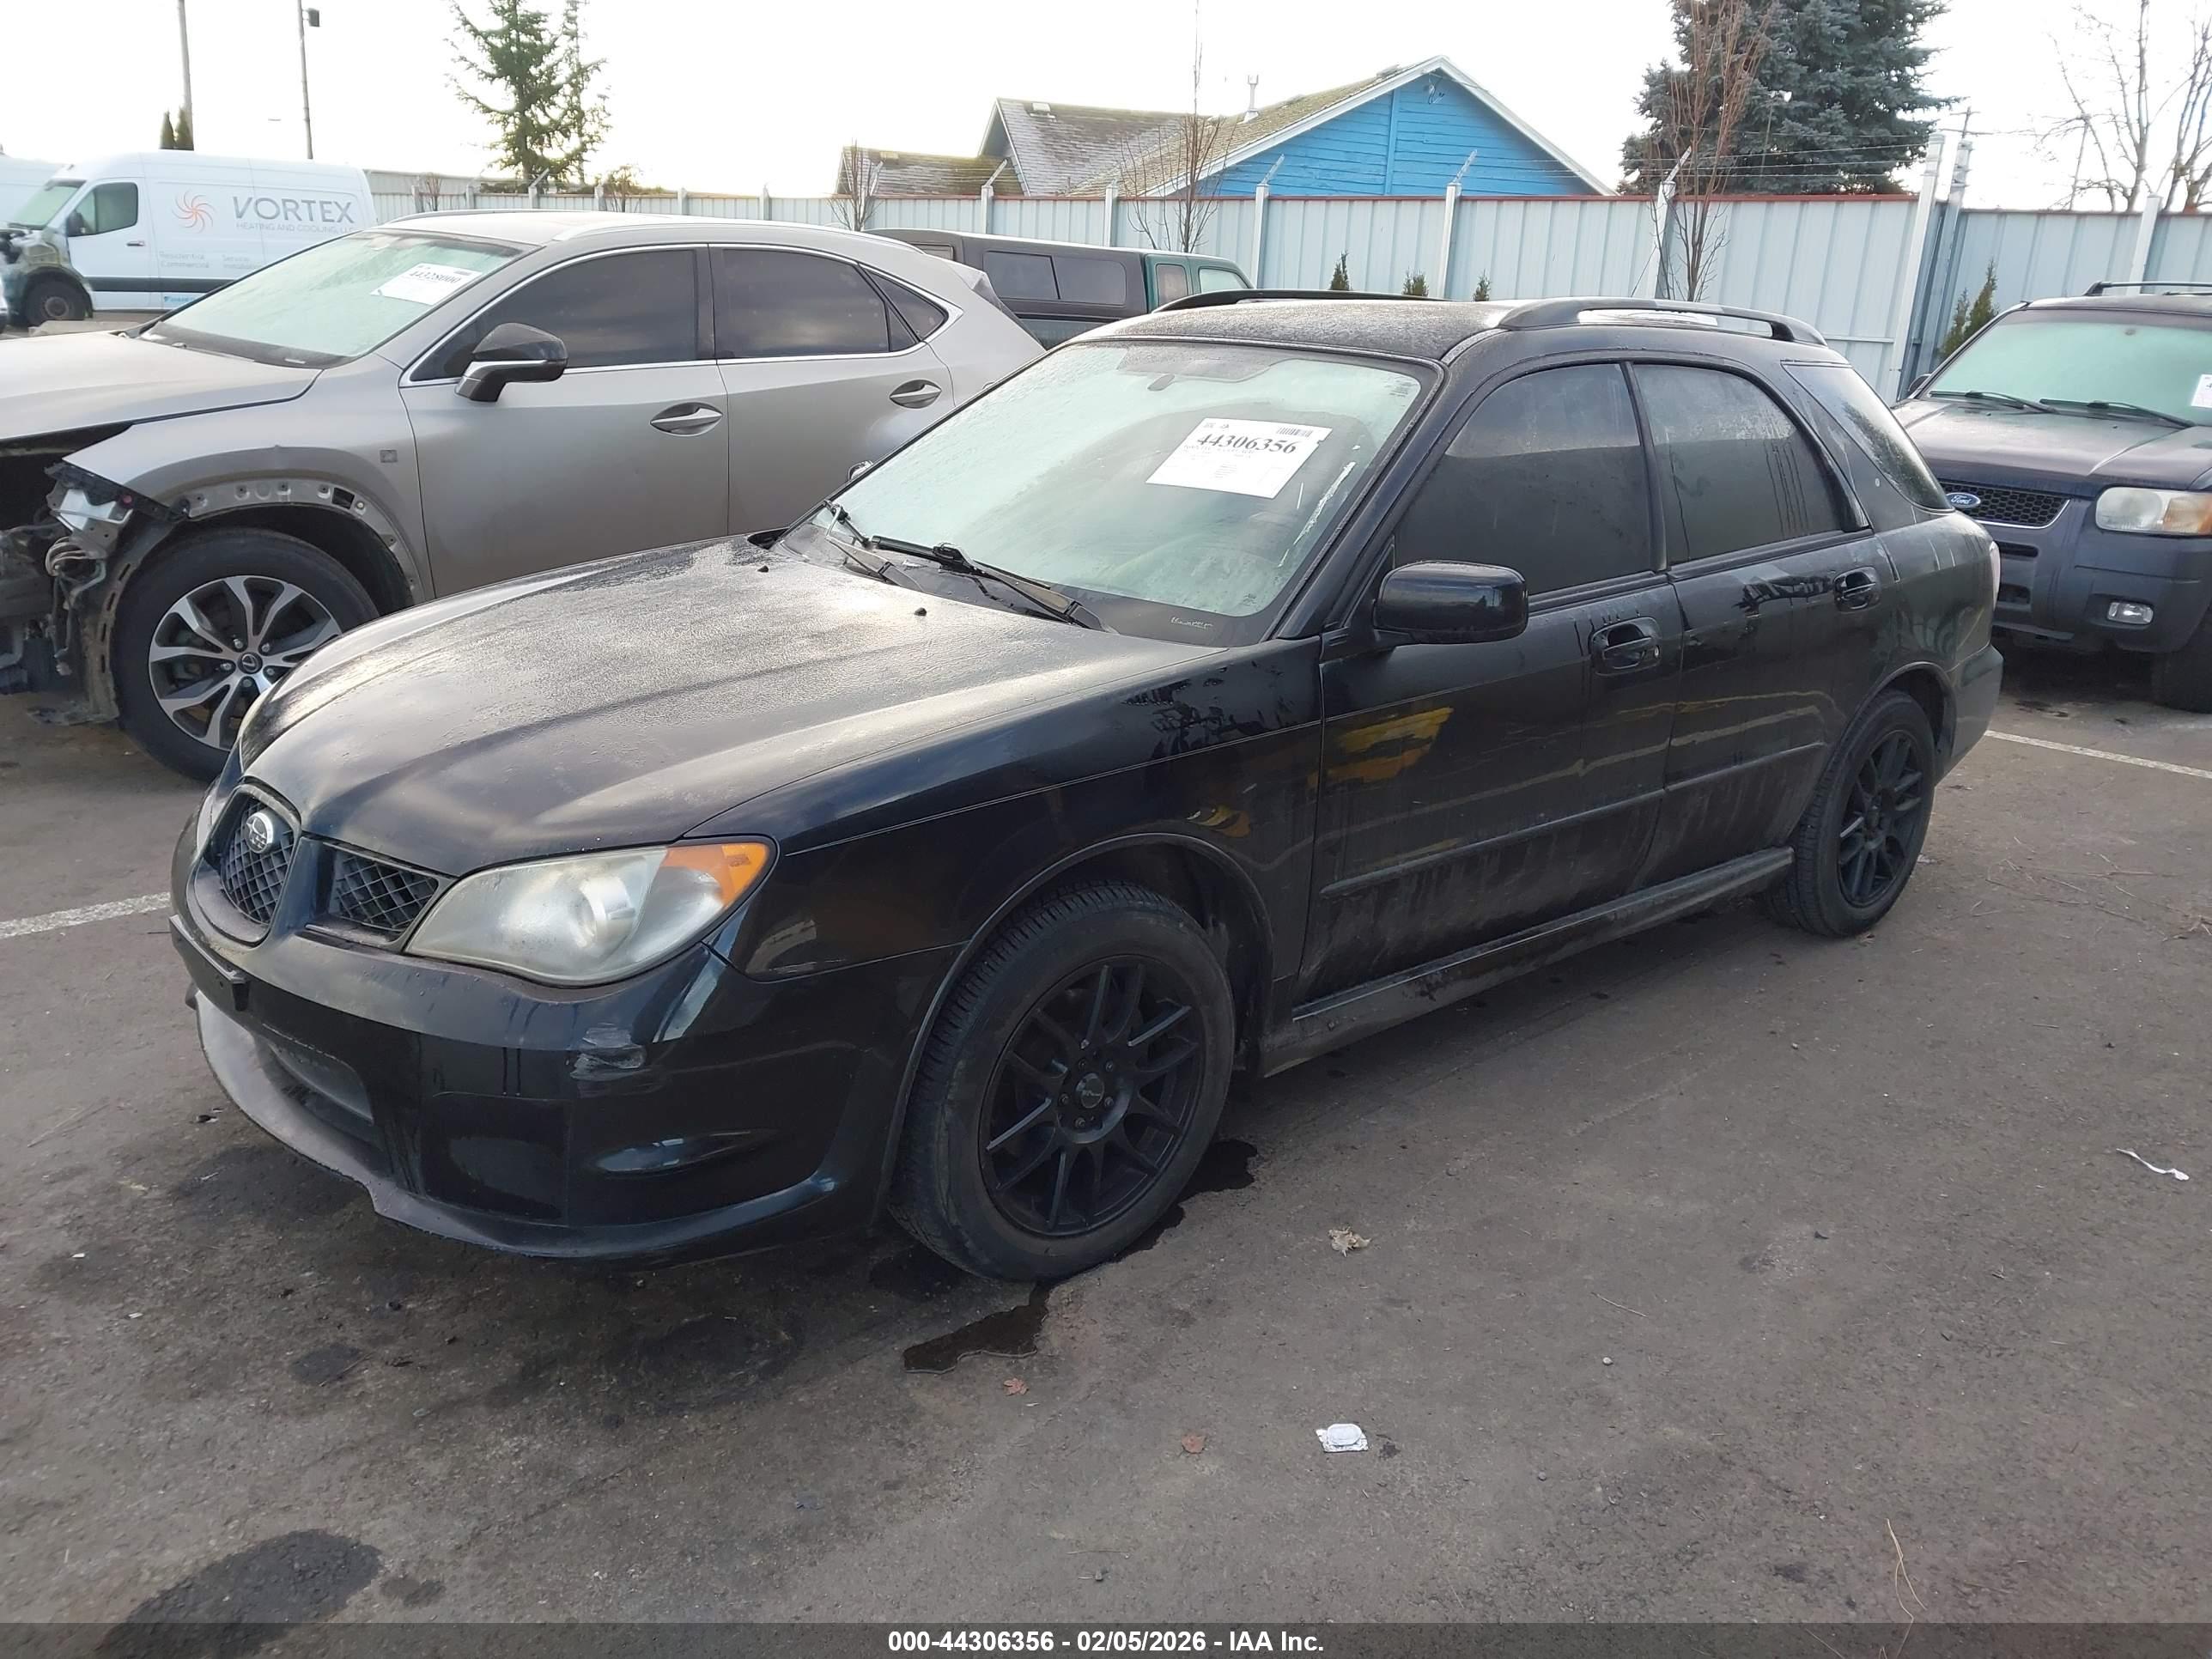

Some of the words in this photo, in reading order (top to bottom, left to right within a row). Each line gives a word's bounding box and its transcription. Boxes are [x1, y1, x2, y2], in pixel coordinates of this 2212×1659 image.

[233, 196, 354, 223] VORTEX
[236, 222, 276, 231] HEATING
[276, 223, 295, 232] AND
[1197, 433, 1301, 454] 44306356
[1950, 495, 1972, 505] Ford
